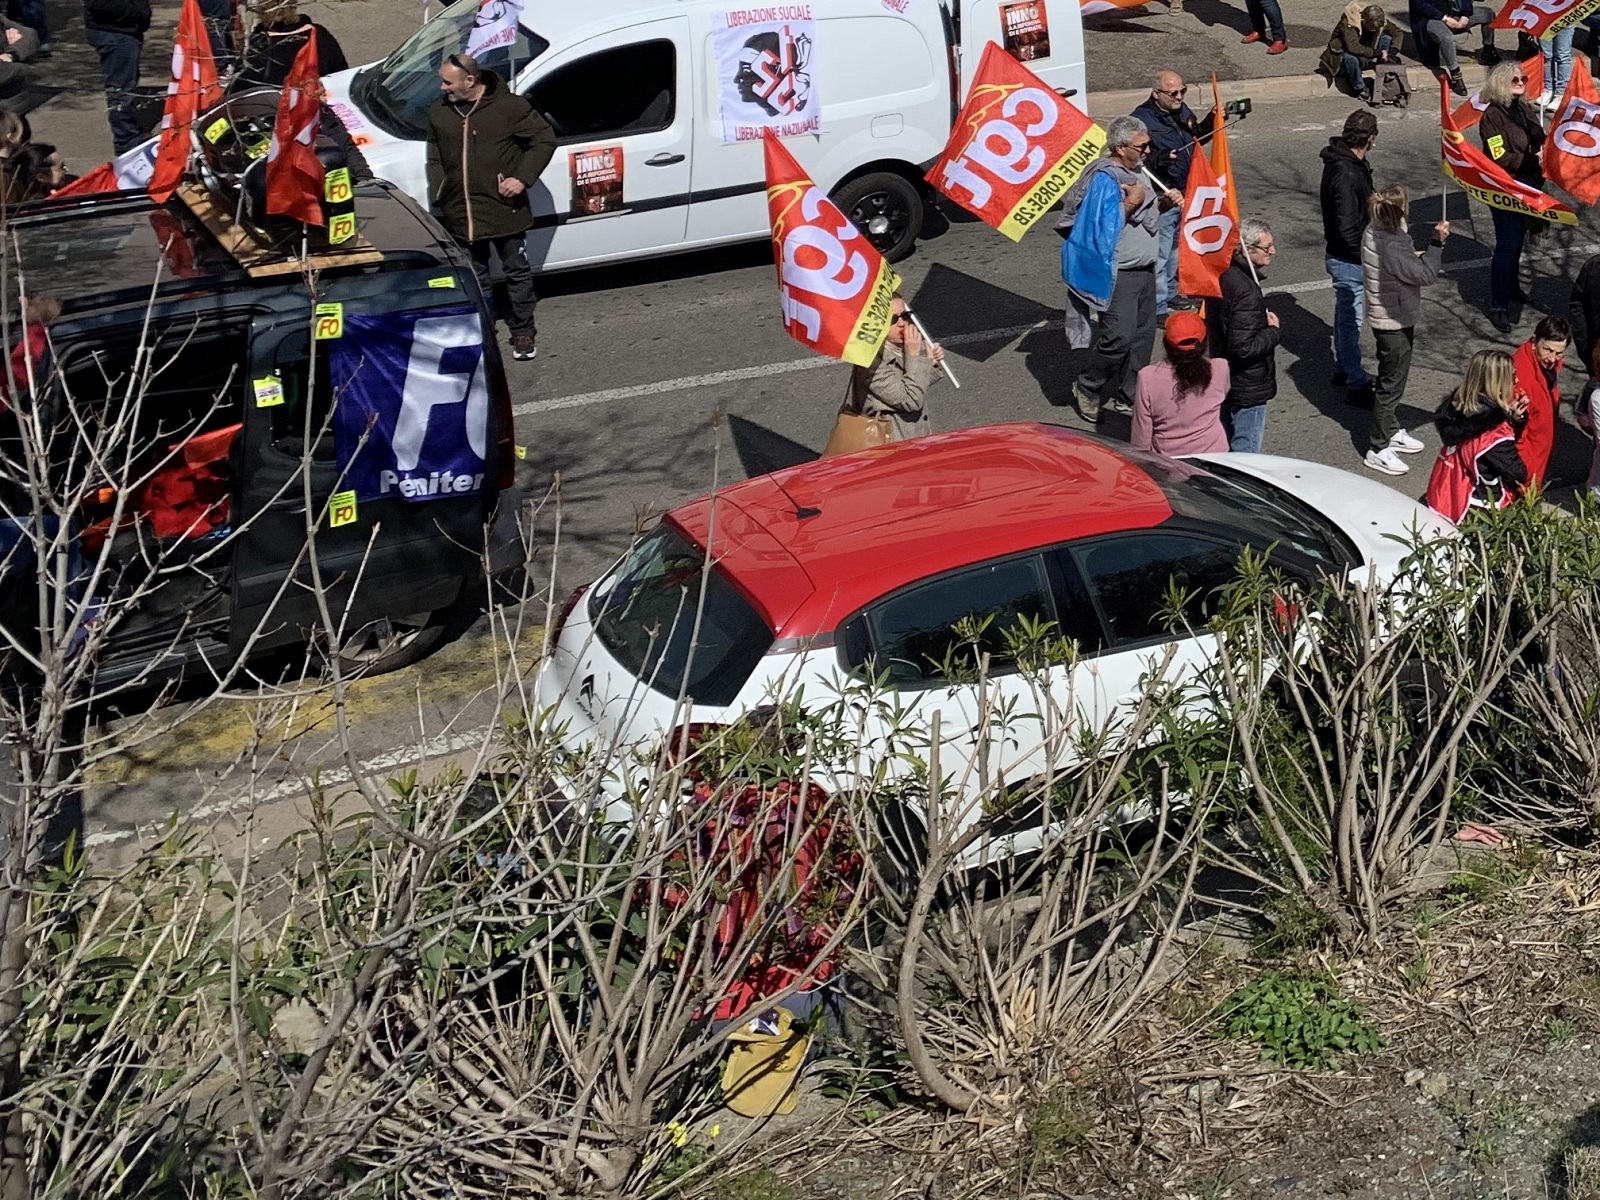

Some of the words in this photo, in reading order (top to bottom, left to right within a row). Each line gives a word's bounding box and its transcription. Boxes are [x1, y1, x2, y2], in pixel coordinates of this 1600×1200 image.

[725, 7, 777, 28] LIBERAZIONE
[779, 5, 811, 20] SUCIALE
[330, 183, 348, 200] FO
[334, 220, 352, 237] FO
[318, 319, 339, 337] FO
[334, 506, 353, 525] FO
